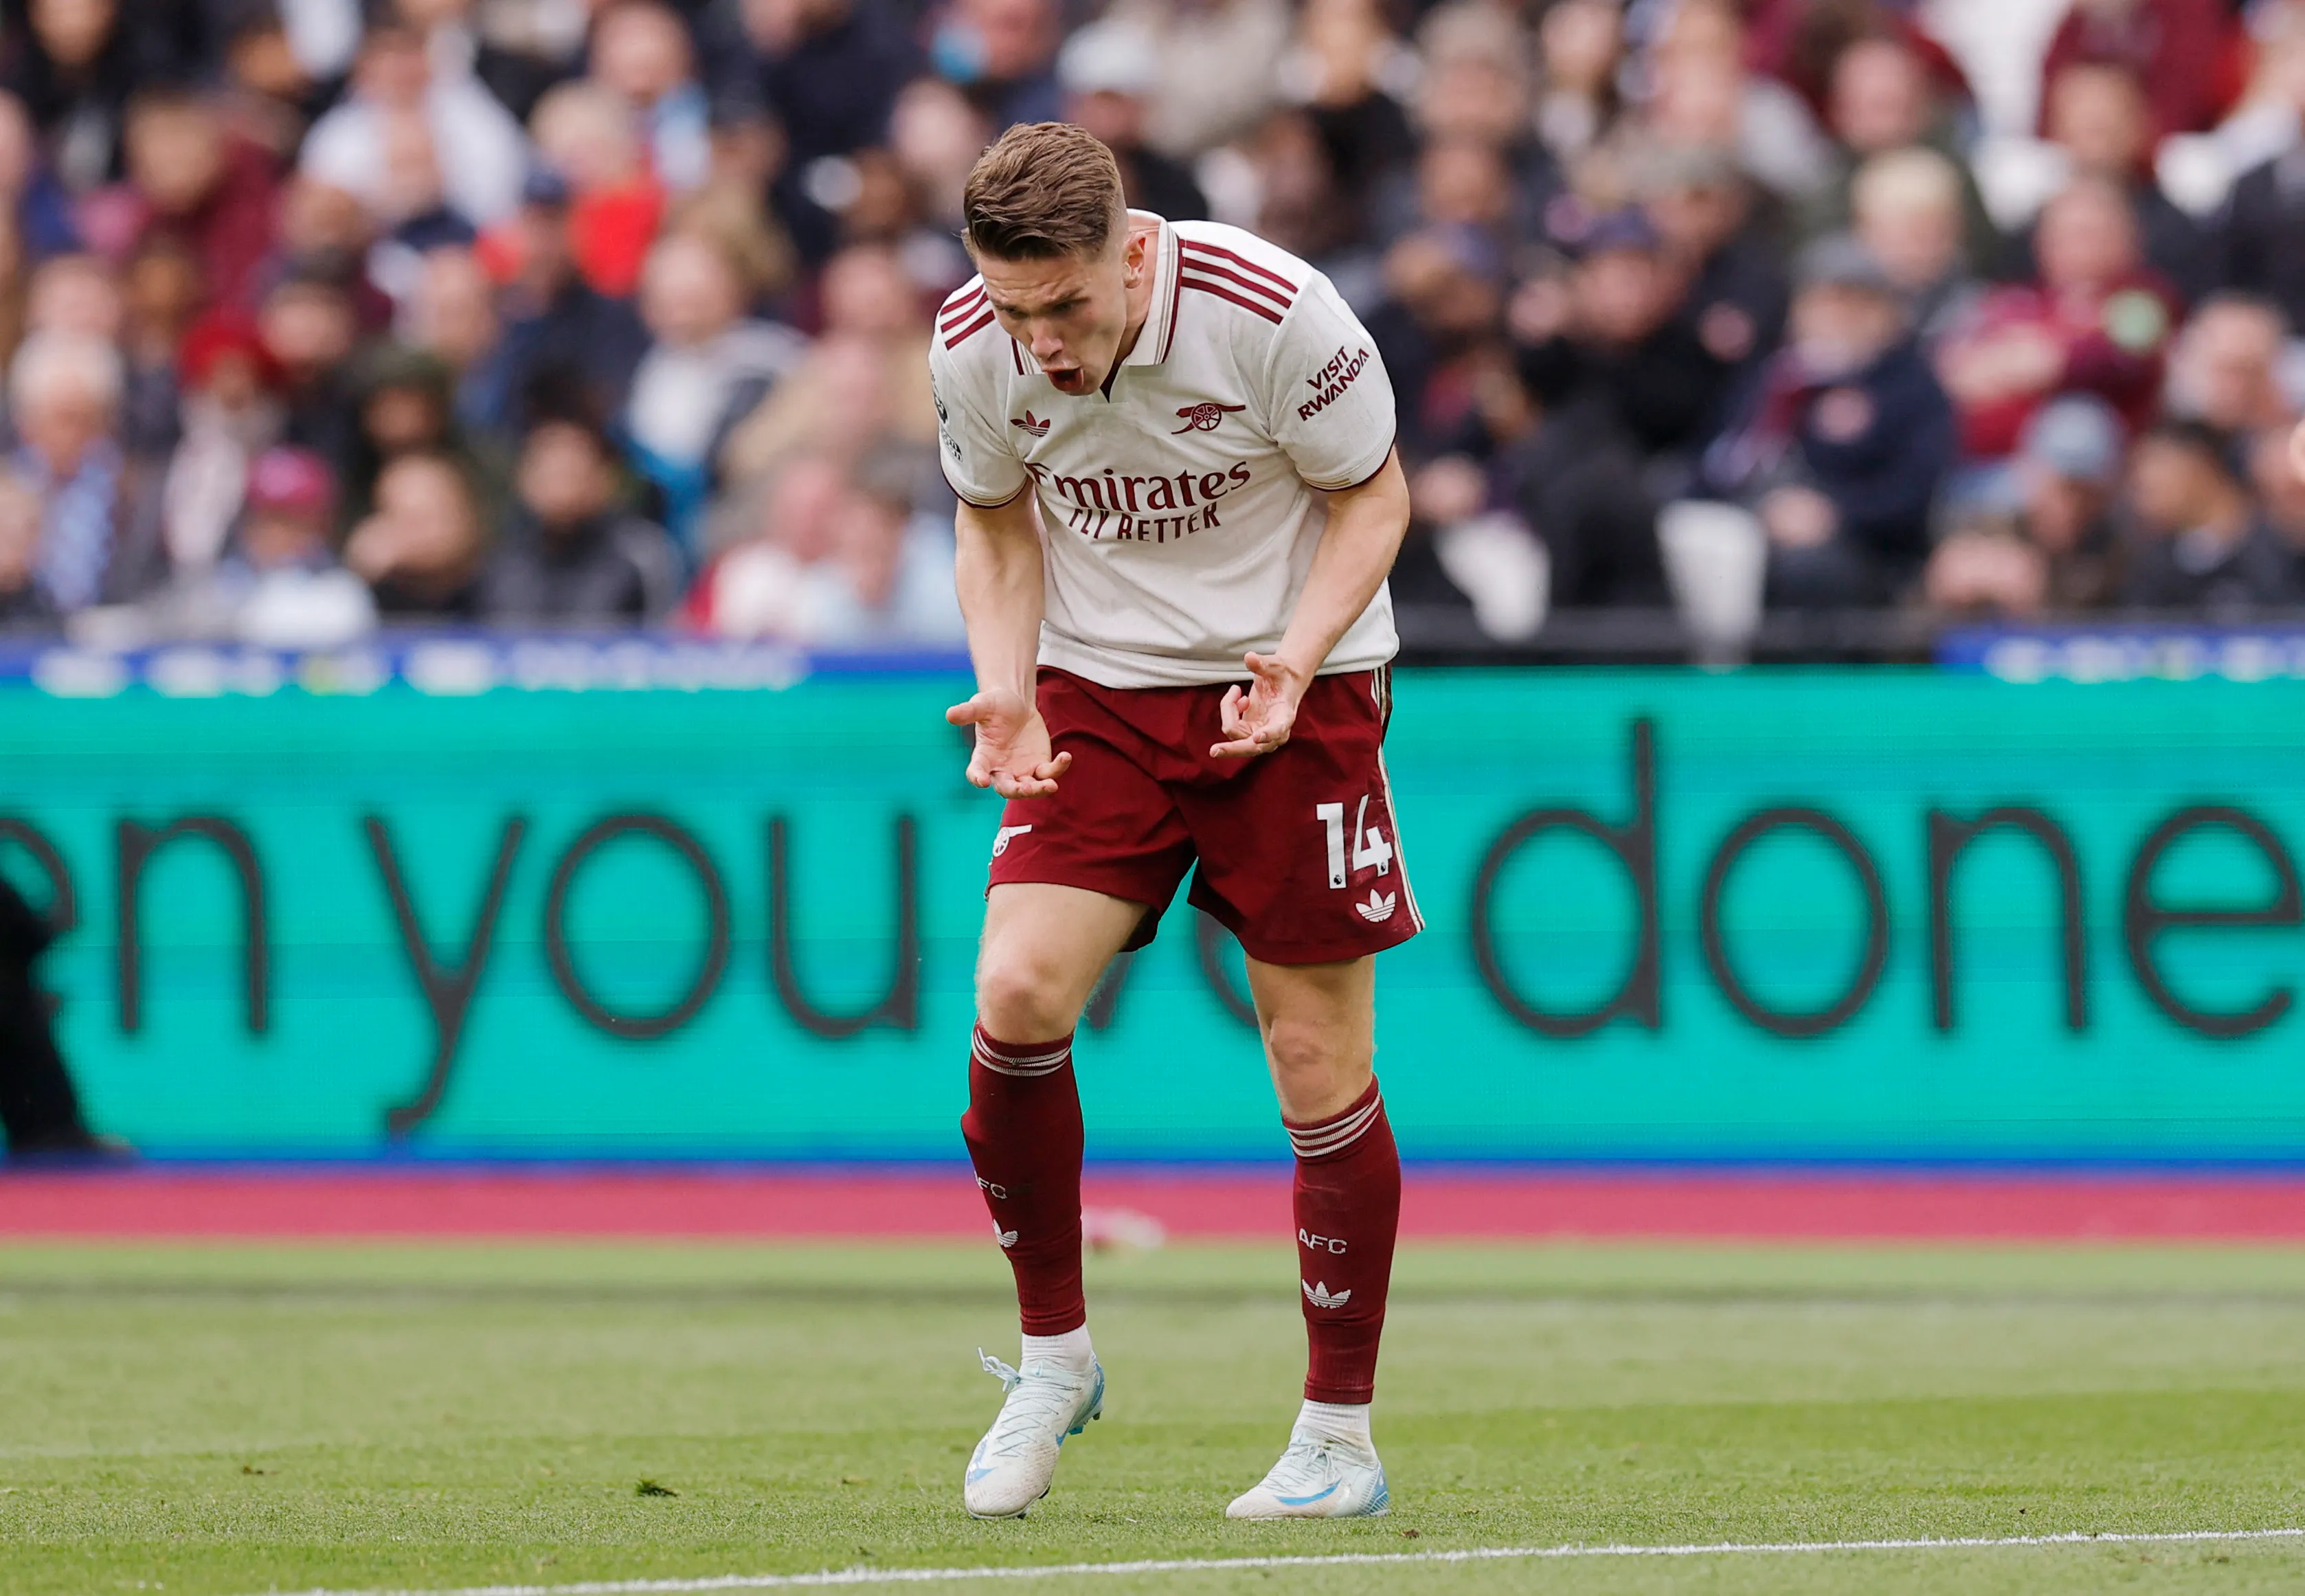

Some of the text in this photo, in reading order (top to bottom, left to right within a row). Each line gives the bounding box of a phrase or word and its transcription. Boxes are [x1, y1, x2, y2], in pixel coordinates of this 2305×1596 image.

[1297, 348, 1369, 421] RWANDA
[1306, 346, 1349, 390] VISIT
[1316, 794, 1393, 889] 14
[1470, 716, 2304, 1038] done
[1298, 1228, 1347, 1255] AFC
